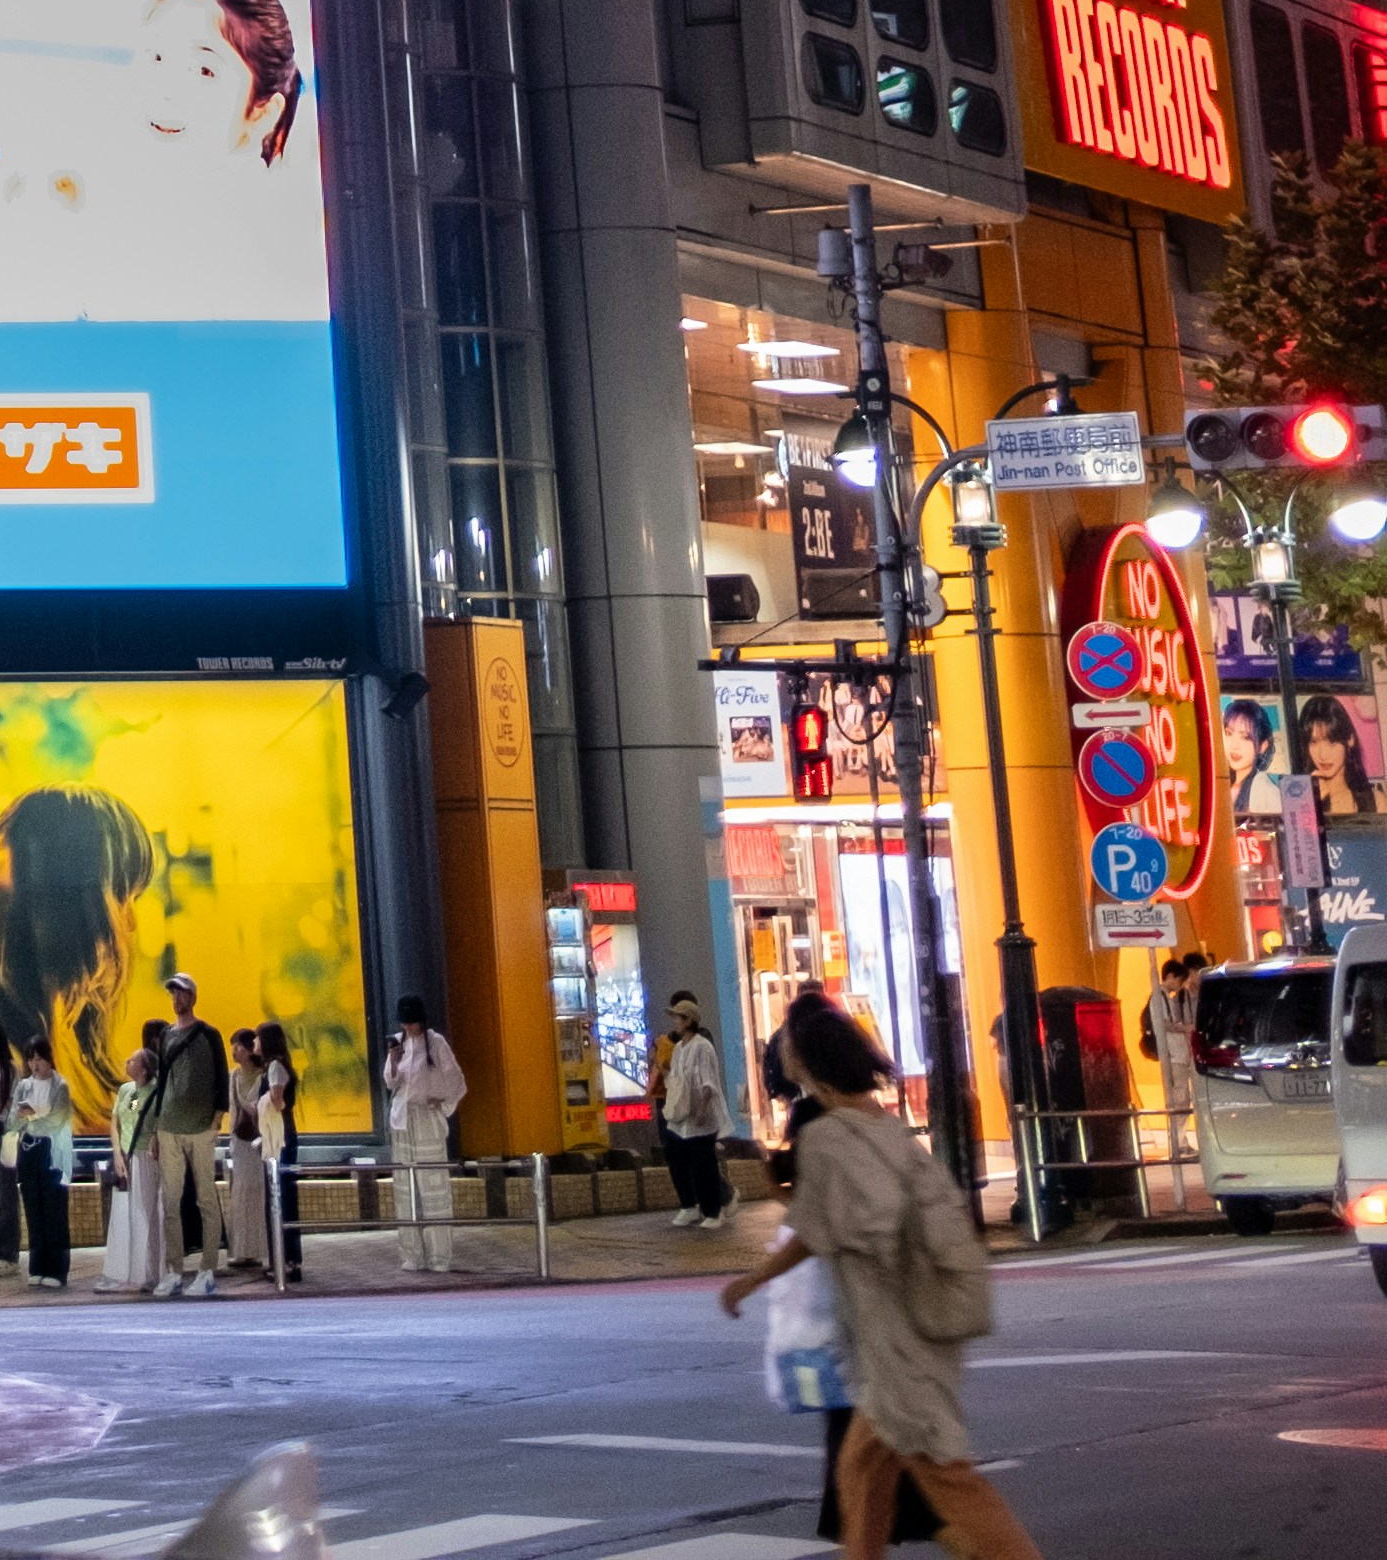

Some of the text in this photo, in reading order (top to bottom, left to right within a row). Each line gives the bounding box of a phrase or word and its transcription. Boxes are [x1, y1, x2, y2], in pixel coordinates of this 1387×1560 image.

[997, 424, 1132, 460] 神南郵便局前
[998, 456, 1137, 481] Jin-nan Post Office
[1125, 560, 1160, 619] NO
[1145, 706, 1177, 764] NO
[1109, 827, 1143, 840] 7-20
[1108, 844, 1137, 893] P
